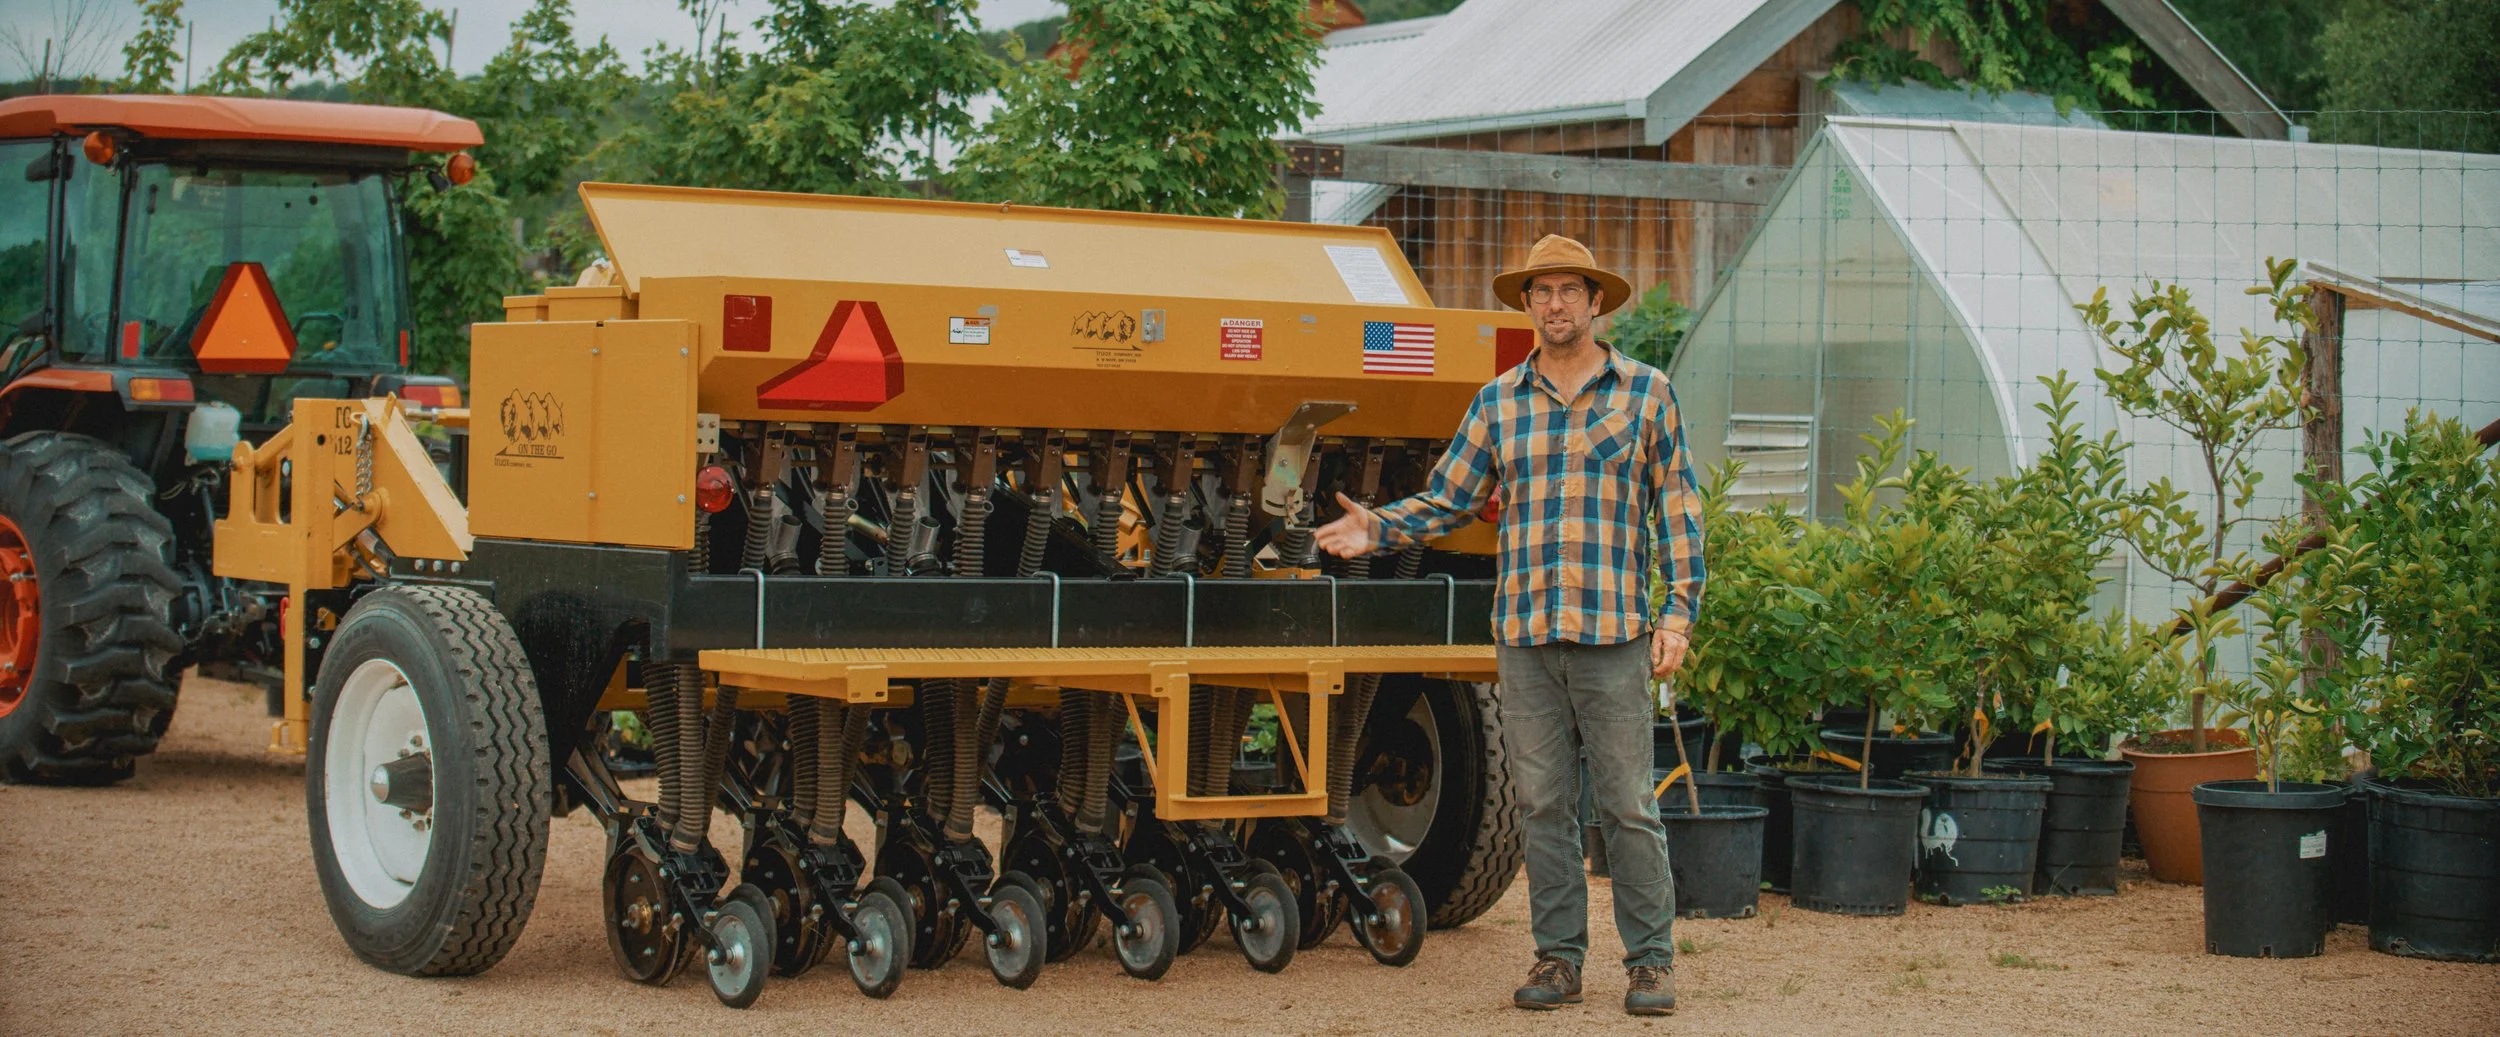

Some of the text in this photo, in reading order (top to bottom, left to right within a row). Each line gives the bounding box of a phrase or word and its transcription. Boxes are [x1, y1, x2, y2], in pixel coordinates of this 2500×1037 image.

[1229, 319, 1261, 327] DANGER
[518, 443, 558, 456] ON THE GO
